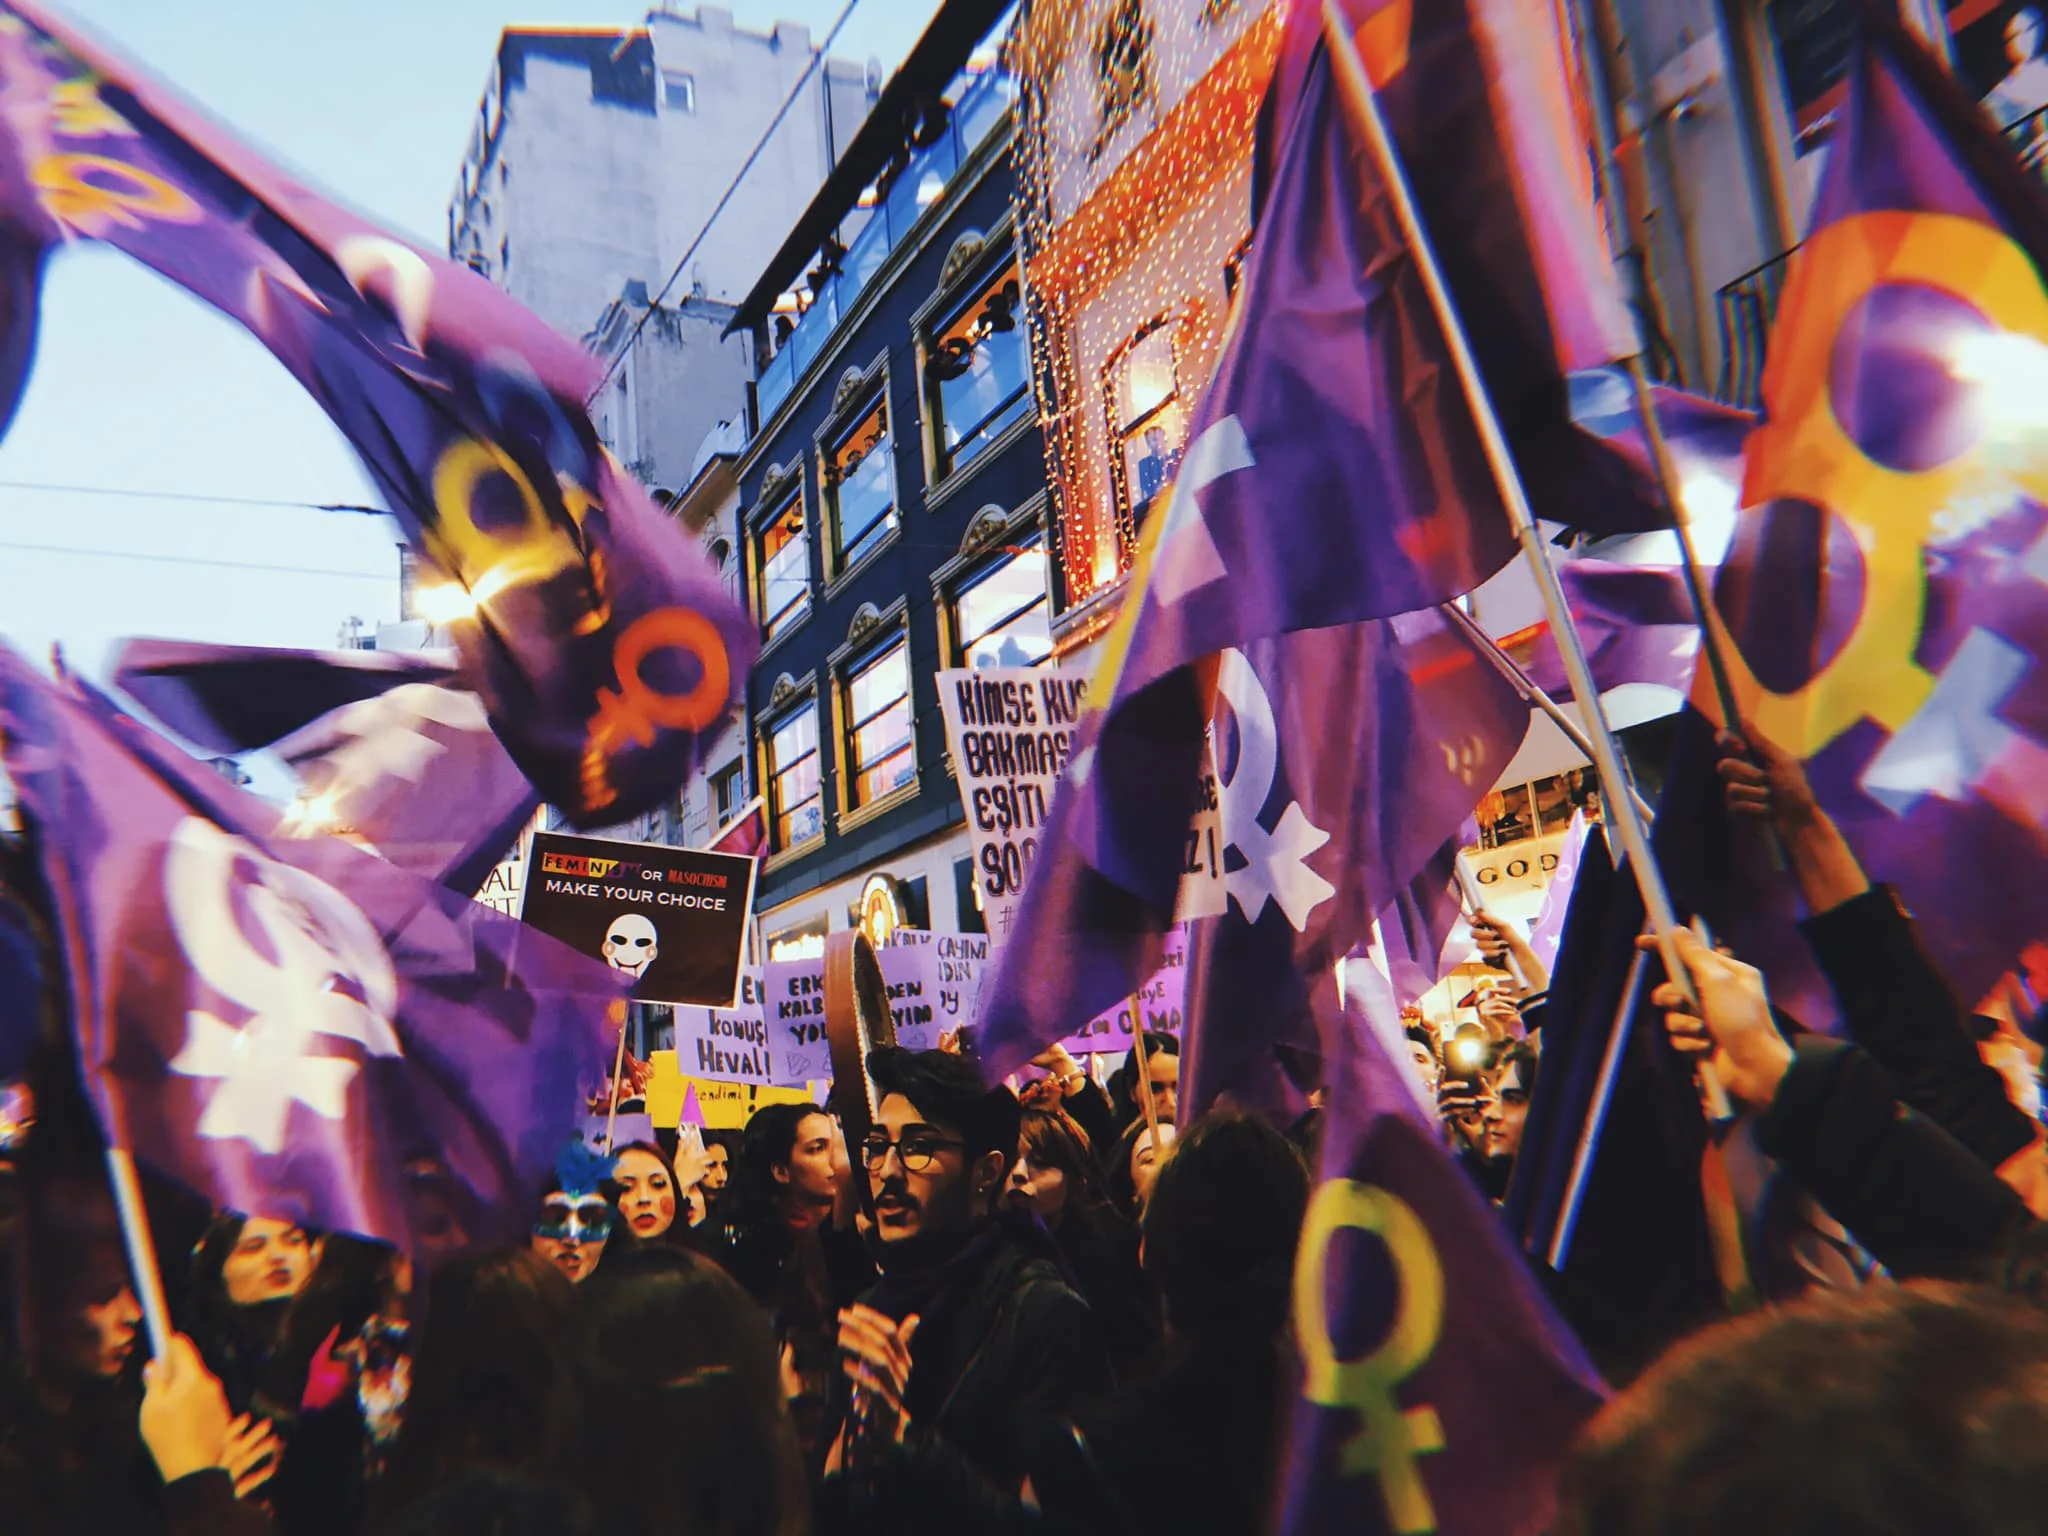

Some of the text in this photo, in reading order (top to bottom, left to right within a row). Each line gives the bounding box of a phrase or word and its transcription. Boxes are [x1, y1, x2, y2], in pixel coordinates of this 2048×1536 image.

[955, 673, 1037, 726] KİMSE
[973, 779, 1052, 839] EŞİTL
[641, 870, 663, 882] OR
[545, 879, 727, 912] MAKE YOUR CHOICE
[788, 974, 824, 997] ERK
[778, 996, 824, 1019] KALB
[708, 1008, 769, 1047] KONUŞ
[788, 1022, 828, 1046] YOL
